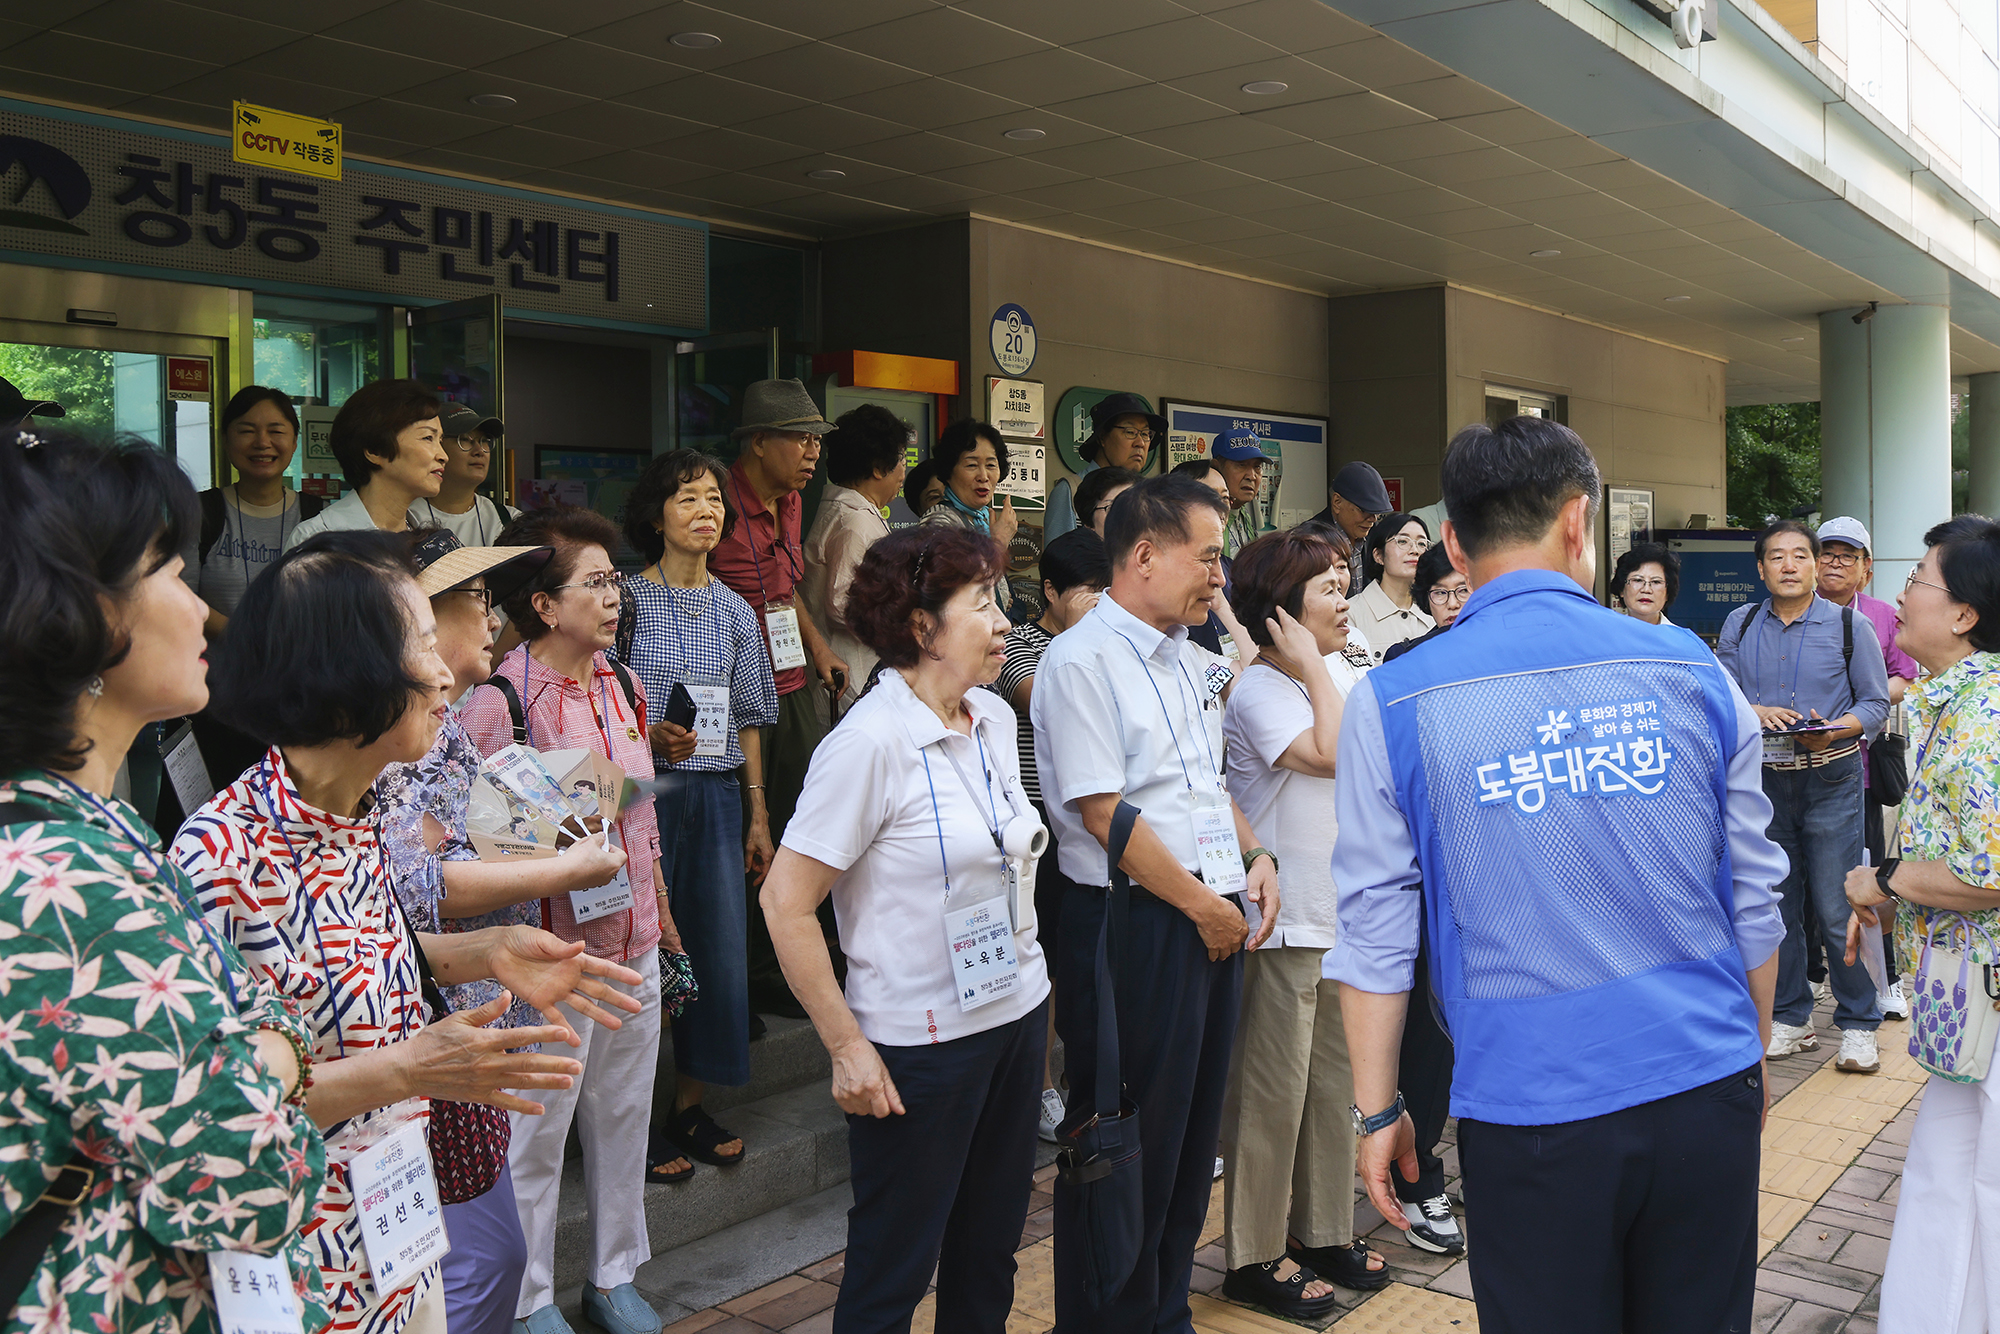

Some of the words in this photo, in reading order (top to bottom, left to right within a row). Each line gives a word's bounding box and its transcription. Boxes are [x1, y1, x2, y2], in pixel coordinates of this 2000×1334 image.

[242, 131, 290, 155] CCTV
[293, 141, 335, 165] 작동중
[115, 152, 327, 263] 창5동
[355, 194, 620, 302] 주민센터
[1005, 332, 1023, 354] 20
[175, 368, 202, 381] 에스원
[1009, 387, 1027, 400] 창5동
[1004, 400, 1031, 413] 자치회관
[1251, 421, 1272, 436] 게시판
[1170, 442, 1185, 452] 스탬프
[1698, 582, 1714, 592] 함께
[1716, 582, 1755, 592] 만들어가는
[1706, 593, 1730, 602] 재활용
[1731, 593, 1748, 602] 문화
[1579, 705, 1618, 723] 문화와
[1620, 700, 1658, 717] 경제가
[1592, 722, 1618, 738] 살아
[1620, 720, 1634, 734] 숨
[1636, 717, 1661, 732] 쉬는
[1476, 736, 1672, 814] 도봉대전환
[362, 1187, 390, 1212] 웰다잉을
[391, 1178, 404, 1193] 위한
[405, 1162, 427, 1185] 웰리빙
